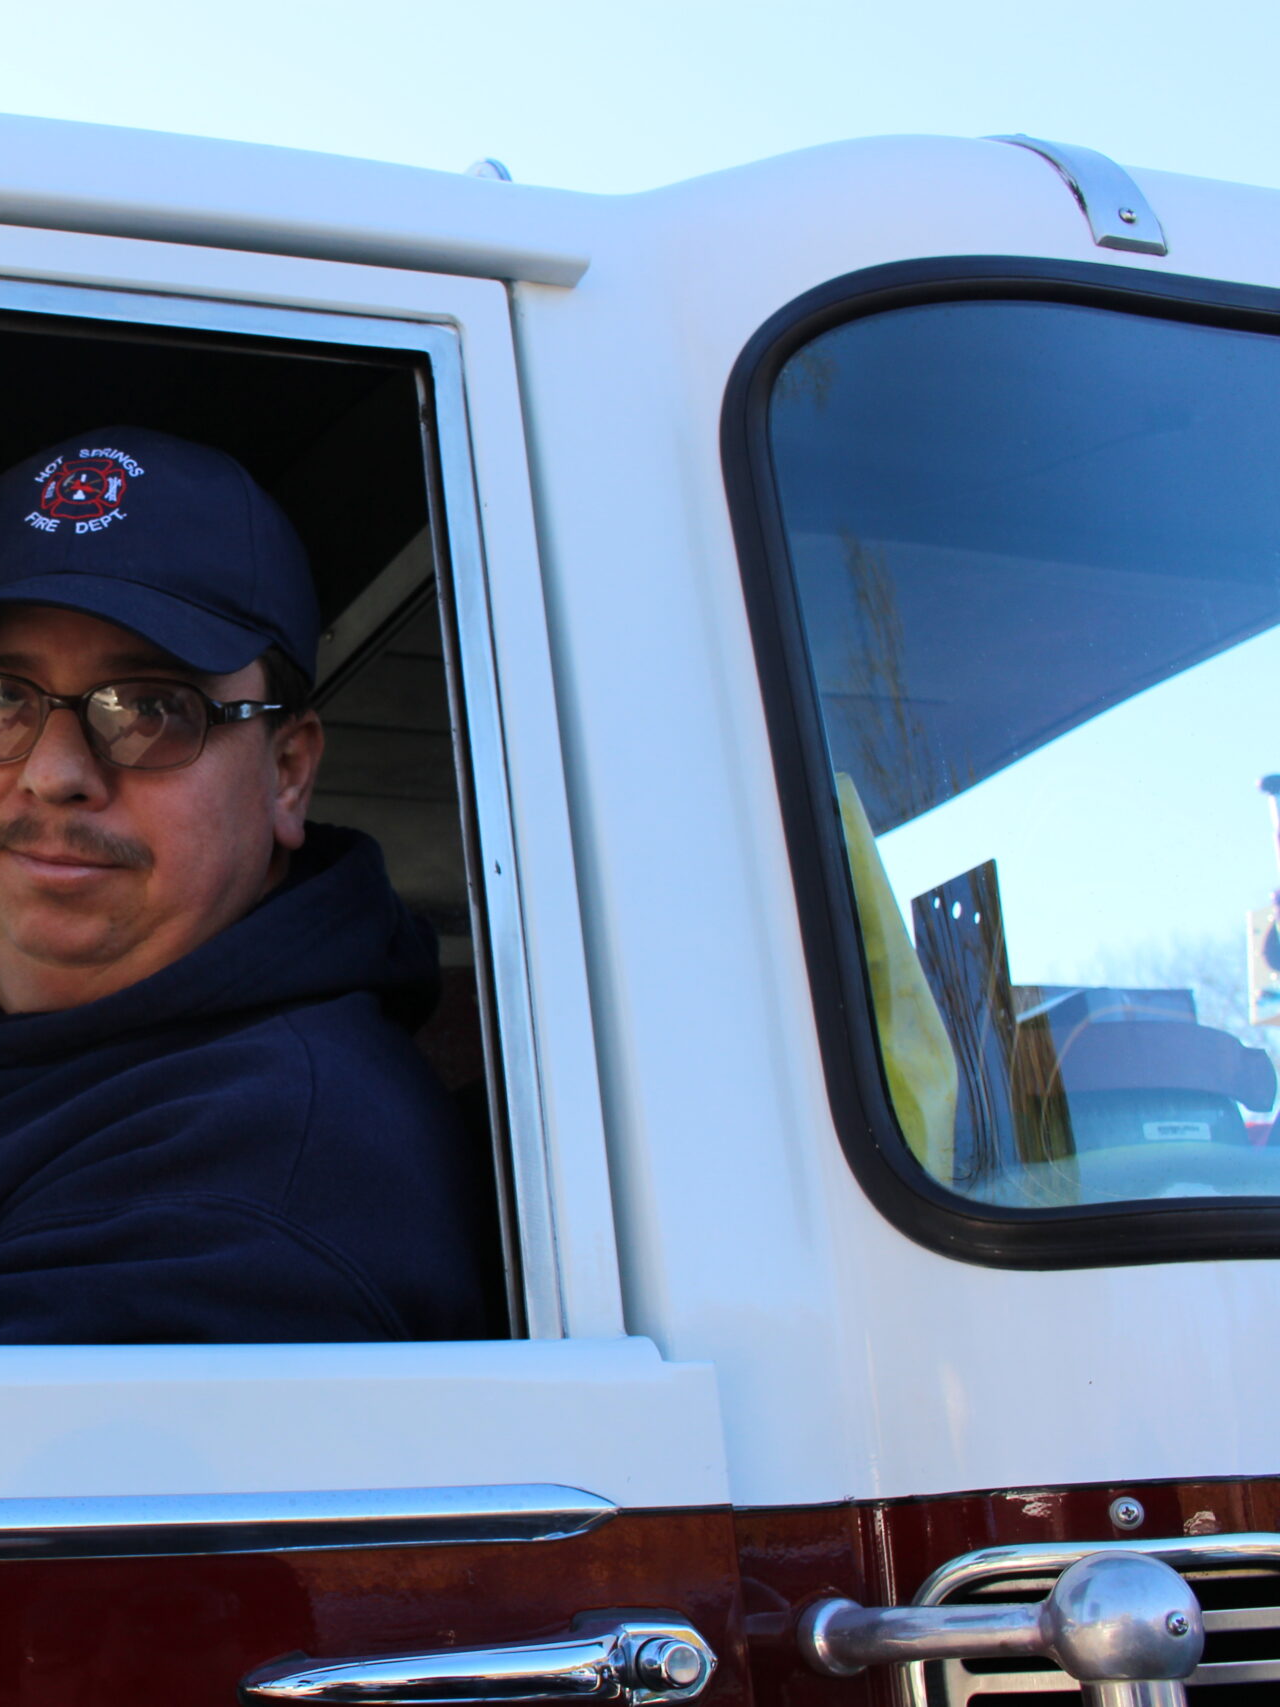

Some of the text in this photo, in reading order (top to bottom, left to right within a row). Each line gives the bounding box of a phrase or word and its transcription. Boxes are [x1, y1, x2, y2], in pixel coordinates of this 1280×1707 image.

[34, 448, 145, 483] HOT SPRINGS
[24, 508, 127, 534] FIRE DEPT.
